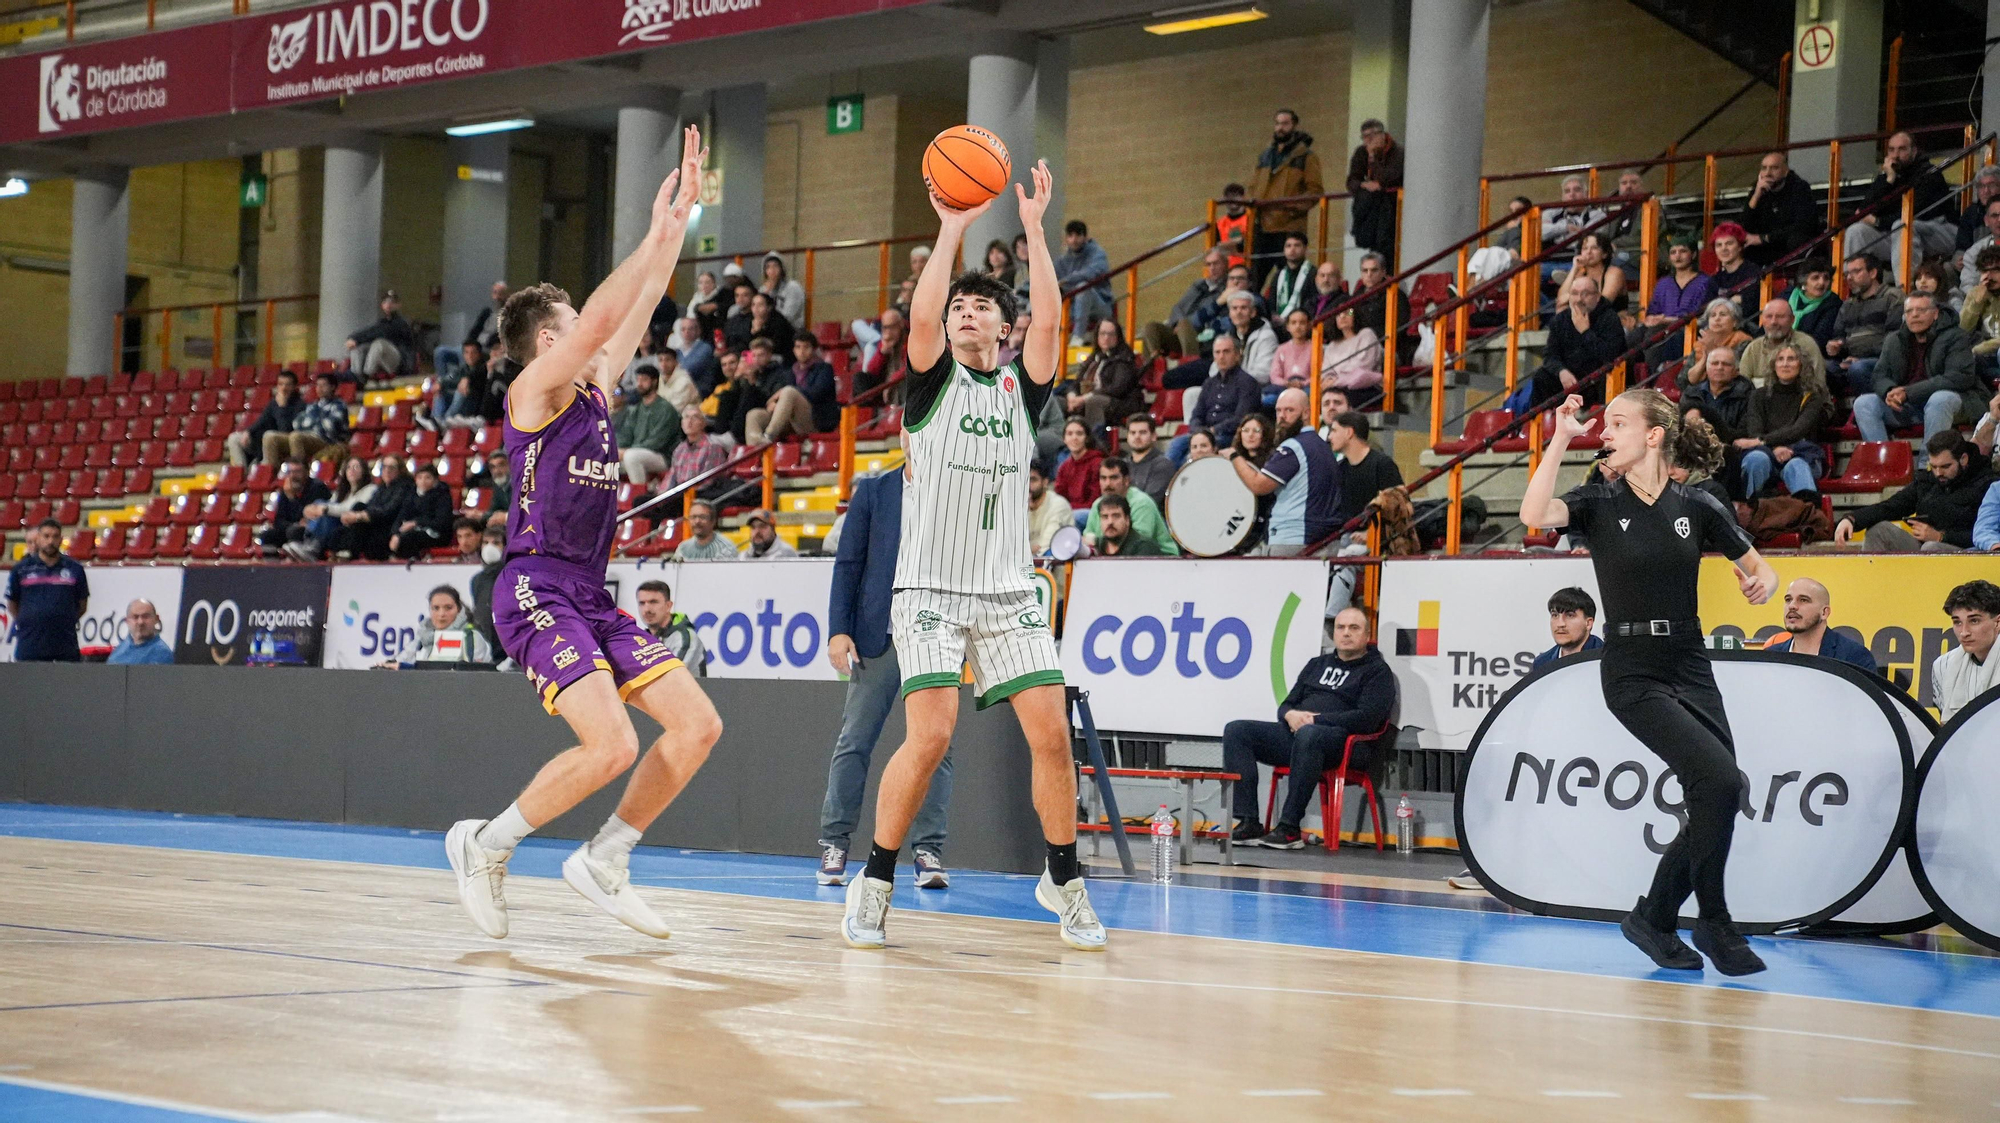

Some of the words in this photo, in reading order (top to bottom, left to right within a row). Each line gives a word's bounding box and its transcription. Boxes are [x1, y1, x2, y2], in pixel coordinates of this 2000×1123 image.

[316, 0, 489, 64] IMDECO
[86, 56, 167, 93] Diputación
[267, 80, 309, 100] Instituto
[310, 69, 364, 94] Municipal
[365, 68, 380, 85] de
[381, 61, 433, 84] Deportes
[434, 53, 485, 75] Córdoba
[86, 95, 104, 118] de
[107, 85, 166, 114] Córdoba
[836, 102, 853, 129] B
[245, 179, 258, 202] A
[947, 461, 992, 475] Fundación
[981, 493, 998, 531] 11
[248, 605, 315, 632] nogomet
[693, 598, 820, 668] coto
[1081, 601, 1253, 680] coto
[553, 645, 579, 667] CBC
[1447, 651, 1536, 677] TheS
[1452, 683, 1510, 708] Kit
